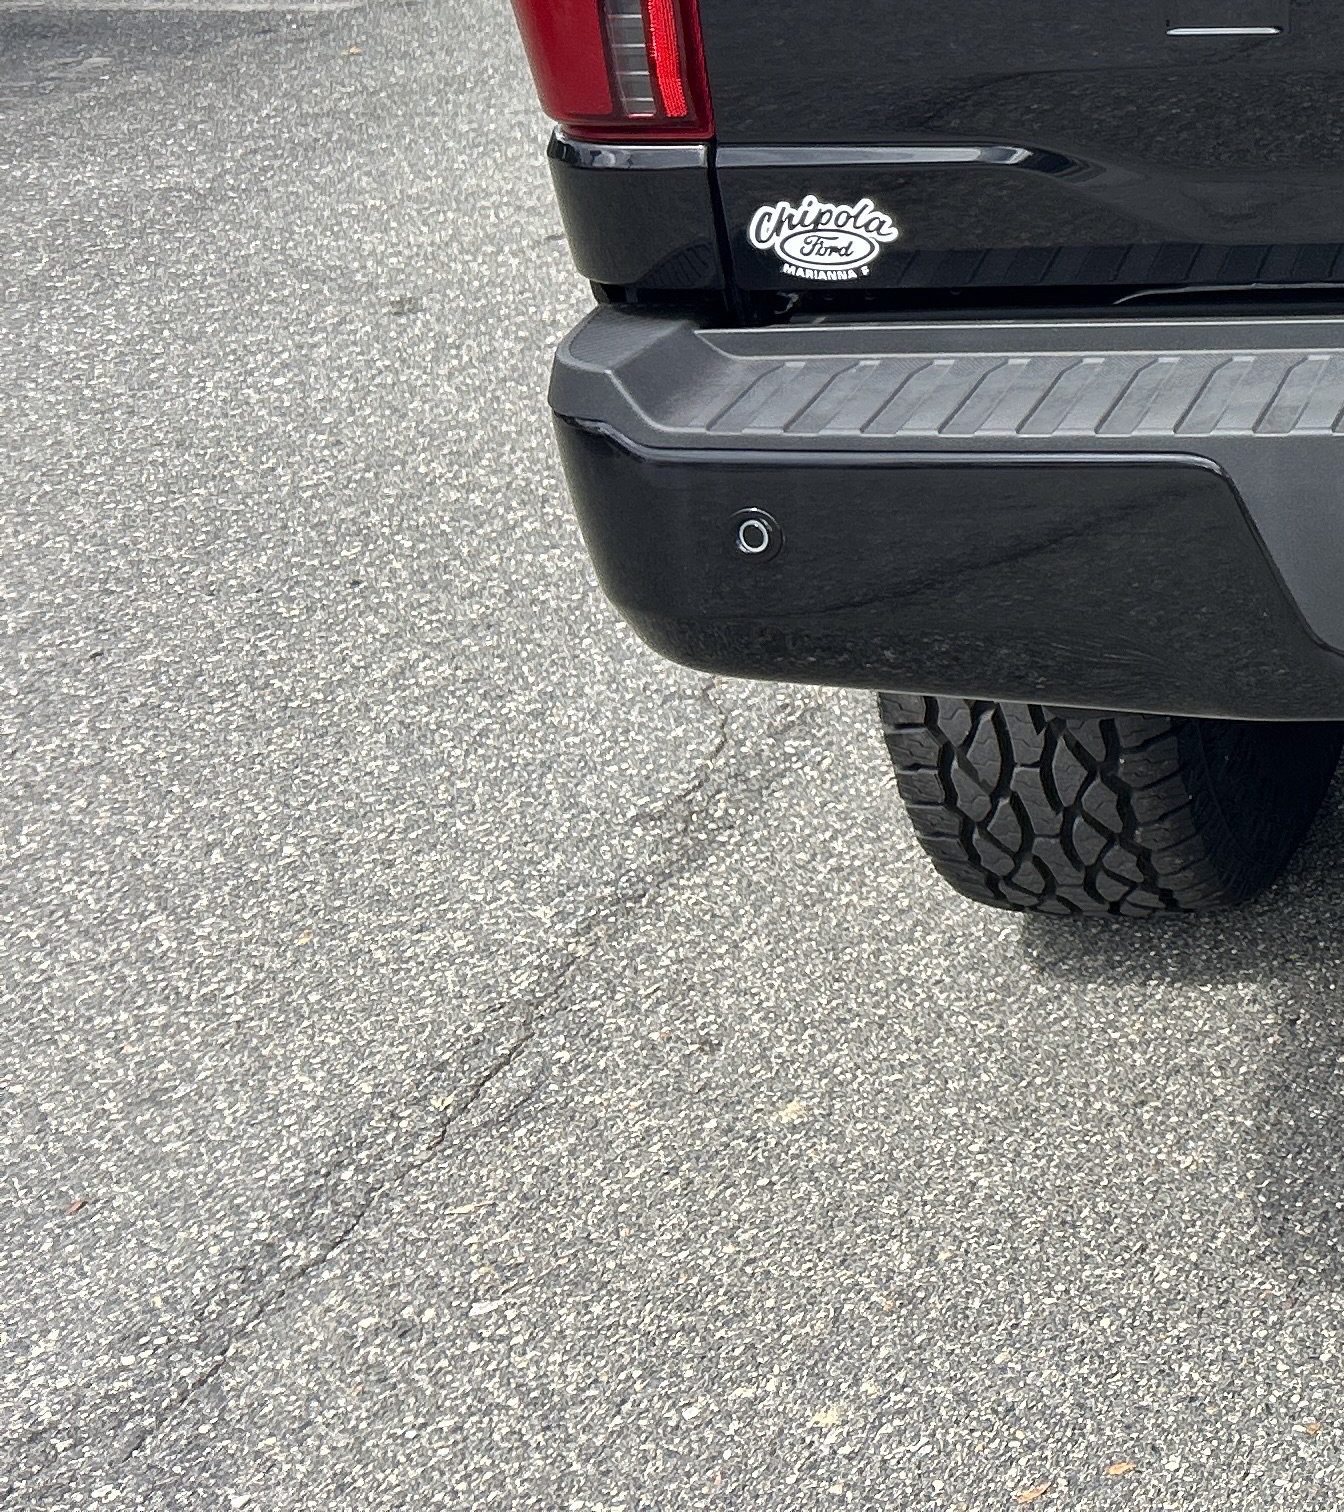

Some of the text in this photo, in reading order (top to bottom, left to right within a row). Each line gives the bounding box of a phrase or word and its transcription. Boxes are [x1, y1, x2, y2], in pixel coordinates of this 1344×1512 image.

[753, 198, 894, 244] Chipola
[799, 234, 854, 257] Ford
[782, 263, 858, 281] MARIANNA
